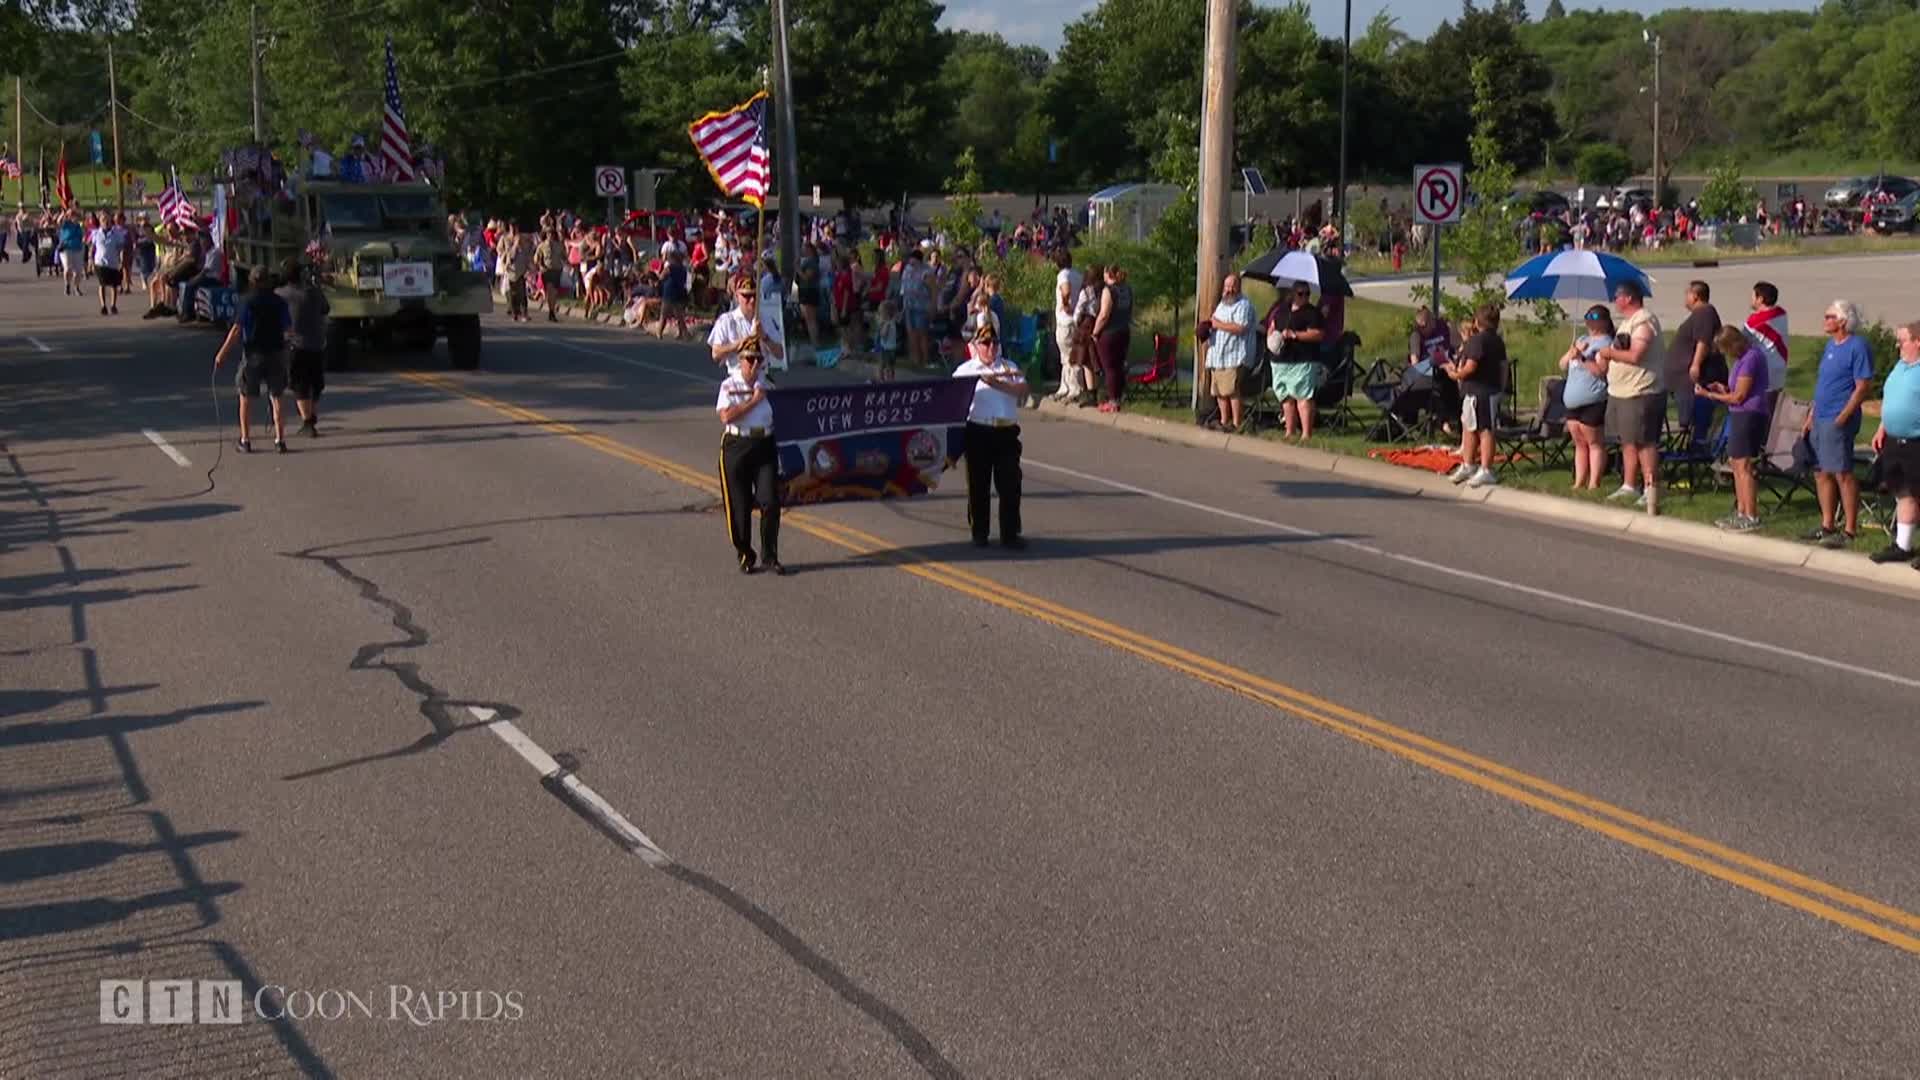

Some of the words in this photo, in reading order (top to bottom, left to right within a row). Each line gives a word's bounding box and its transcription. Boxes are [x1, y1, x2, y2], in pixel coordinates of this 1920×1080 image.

[807, 394, 853, 413] COON
[865, 388, 933, 407] RAPIDS
[817, 413, 853, 432] VFW
[864, 407, 914, 425] 9625
